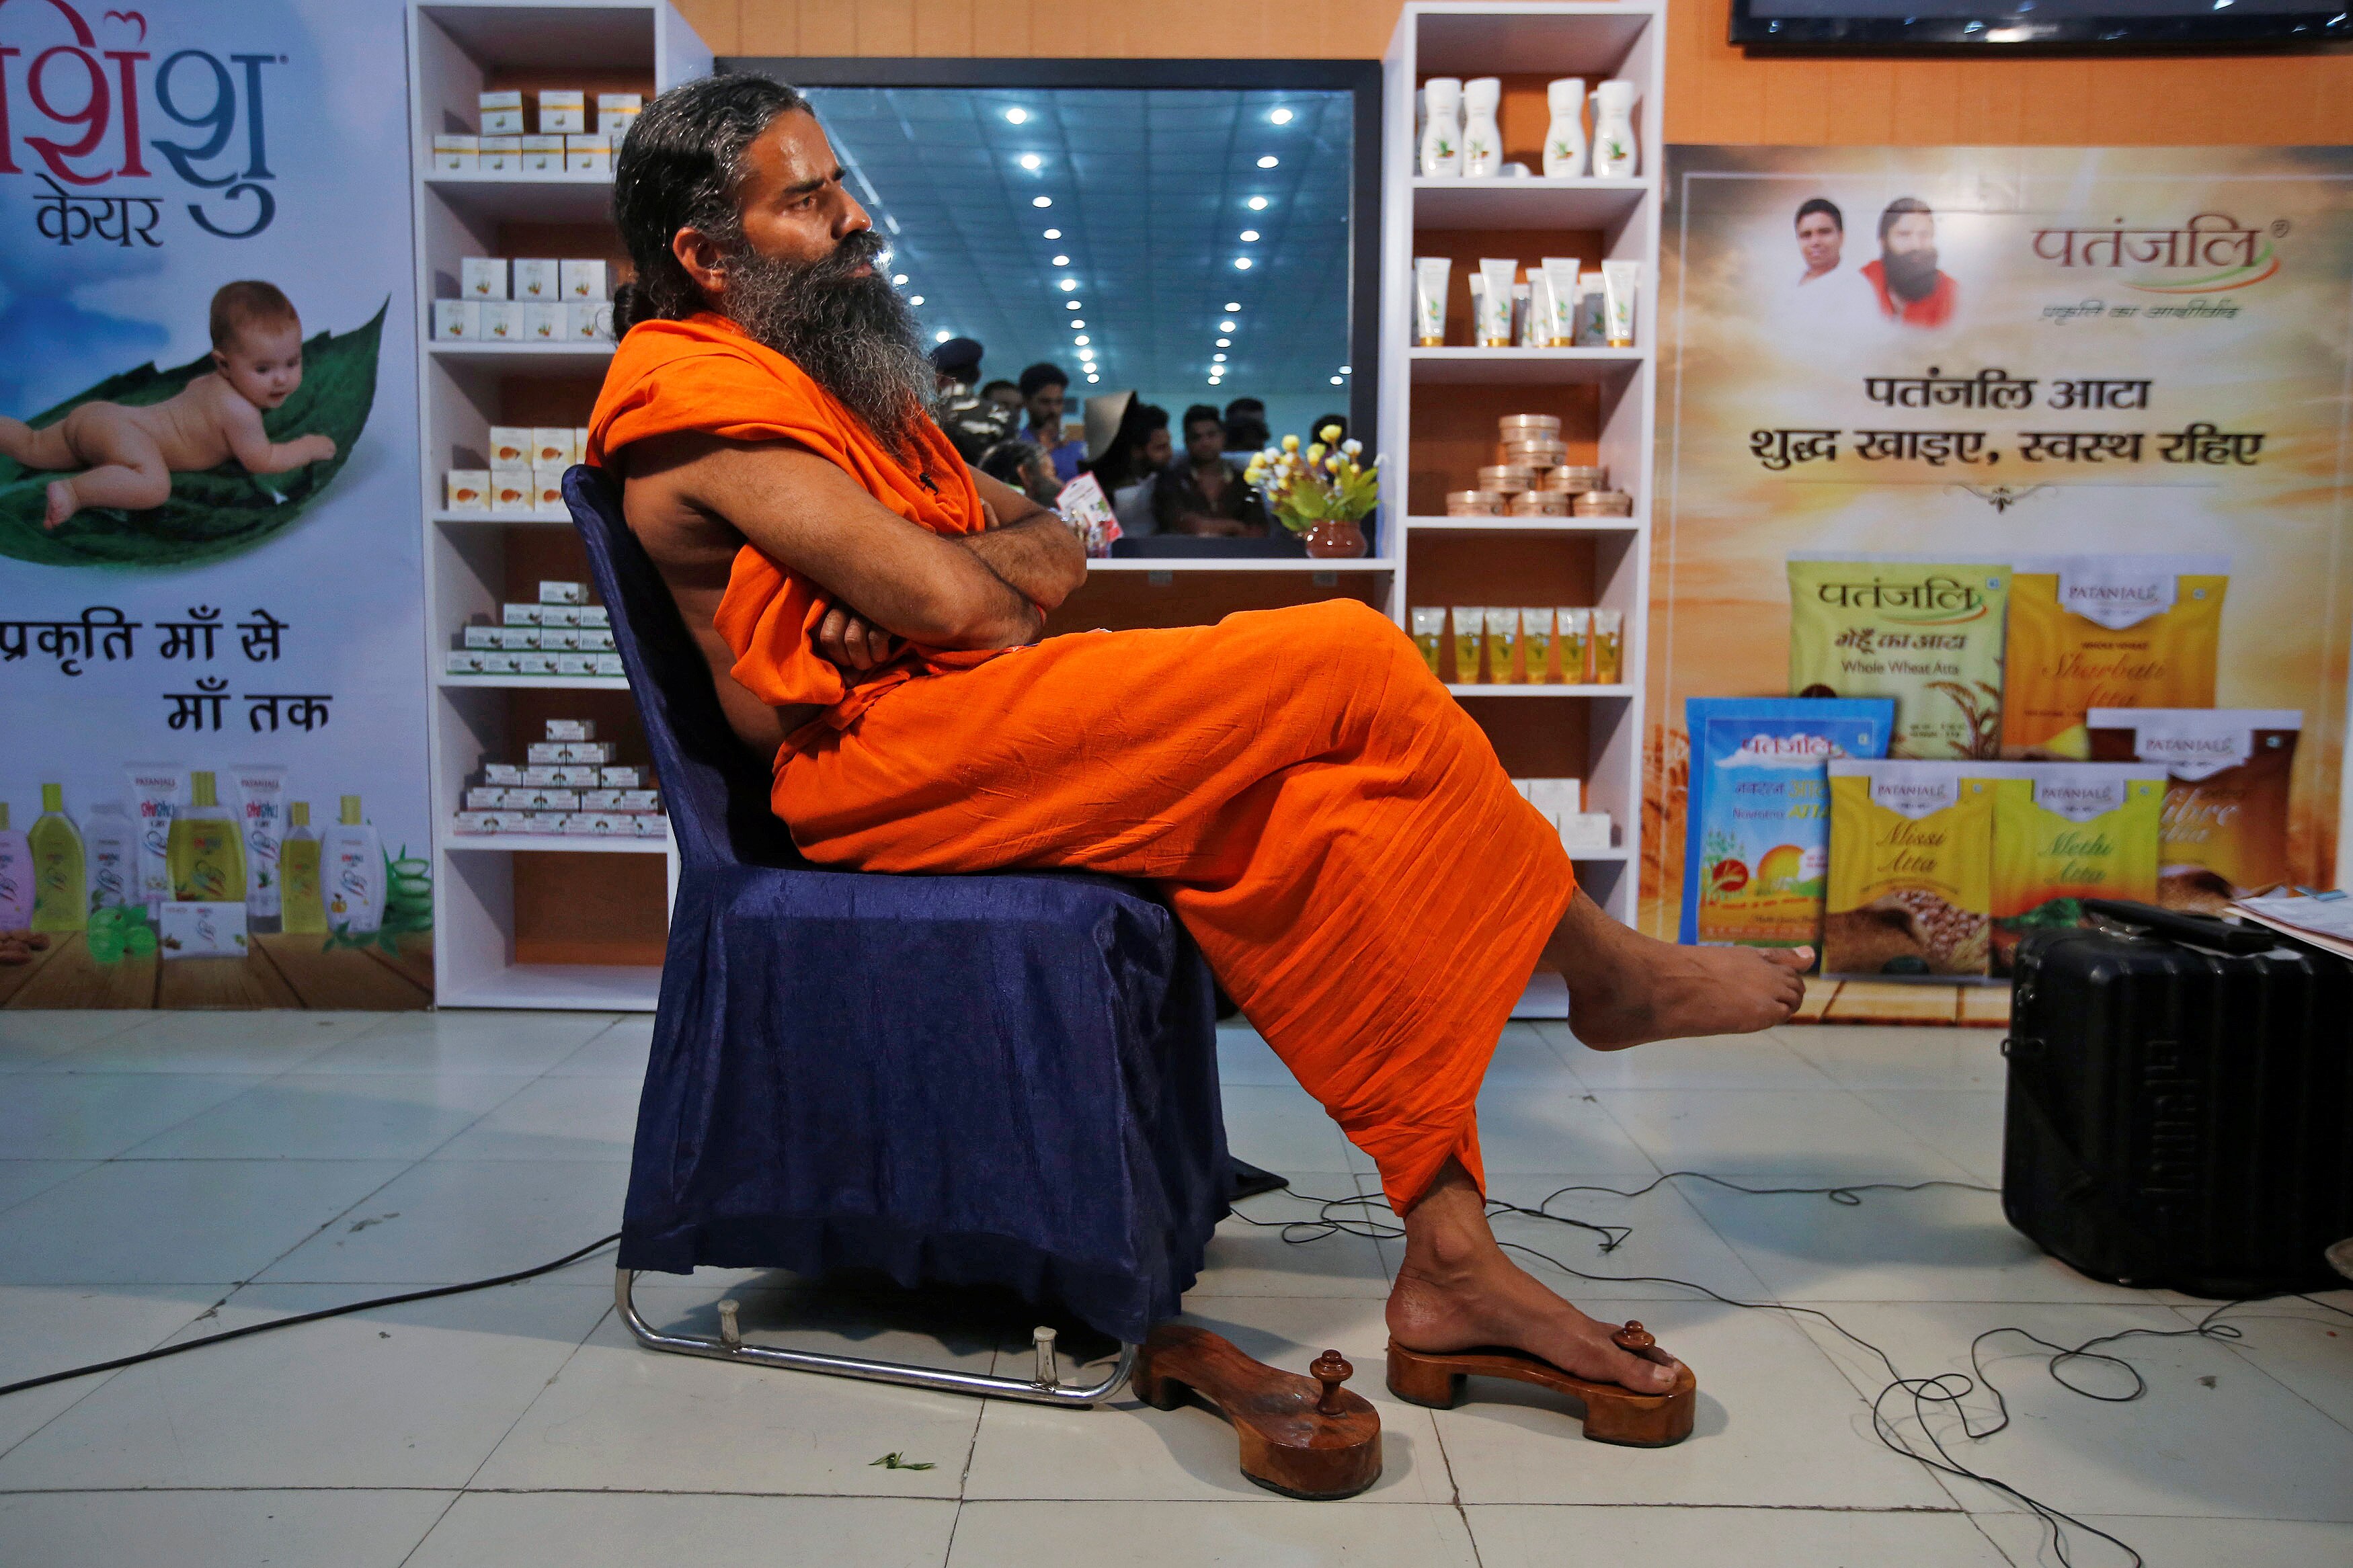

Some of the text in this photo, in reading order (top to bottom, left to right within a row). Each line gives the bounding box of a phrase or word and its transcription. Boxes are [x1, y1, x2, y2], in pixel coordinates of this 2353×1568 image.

[33, 173, 164, 247] केयर
[2031, 214, 2262, 267] पतंजलि
[1864, 366, 2154, 411] पतंजलि आटा
[1749, 427, 1841, 470] शुद्ध
[2017, 430, 2144, 462] स्वस्थ
[2156, 421, 2266, 465] रहिए
[1817, 575, 1975, 609] पतंजलि
[0, 605, 289, 676] प्रकृति माँ से
[1877, 633, 1911, 649] का
[1912, 633, 1968, 650] आटा
[1842, 661, 1960, 675] Whole Wheat Atta
[163, 676, 333, 732] माँ तक
